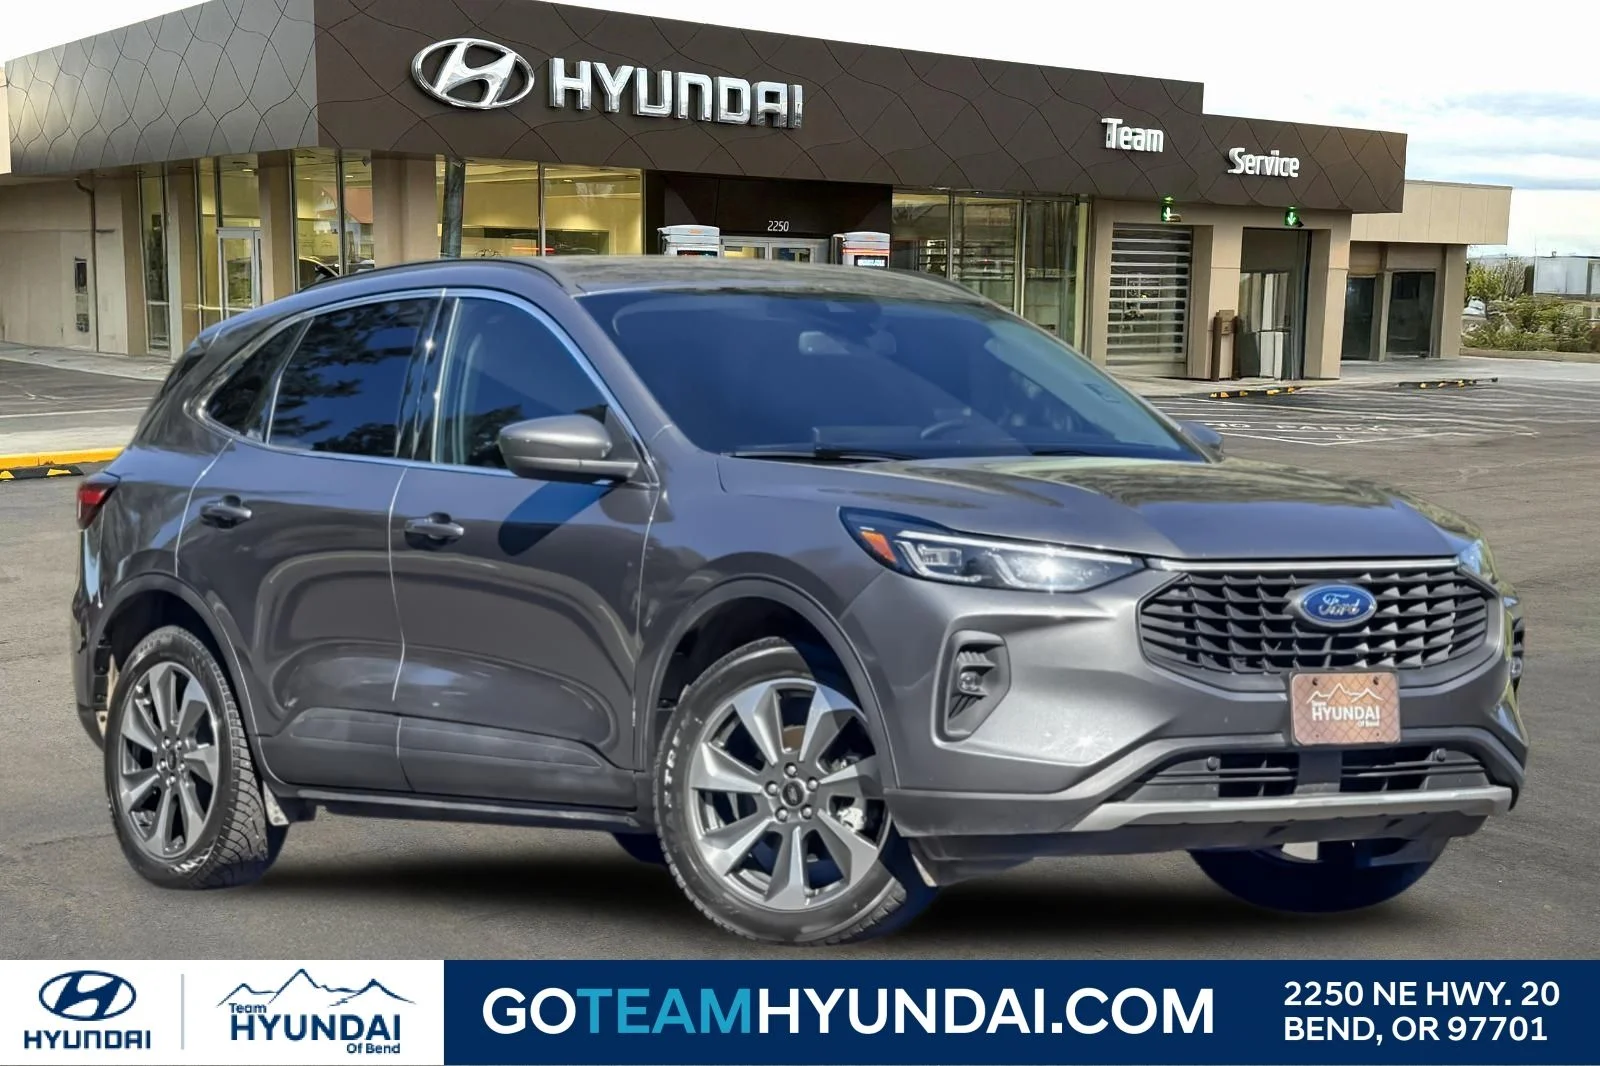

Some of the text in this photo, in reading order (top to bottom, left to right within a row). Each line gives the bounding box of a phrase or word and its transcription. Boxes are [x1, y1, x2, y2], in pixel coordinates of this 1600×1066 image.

[548, 56, 803, 129] HYUNDAI
[1101, 117, 1164, 153] Team
[1227, 147, 1300, 178] Service
[767, 220, 790, 232] 2250
[1318, 592, 1361, 616] Ford
[1311, 704, 1380, 721] HYUNDAI
